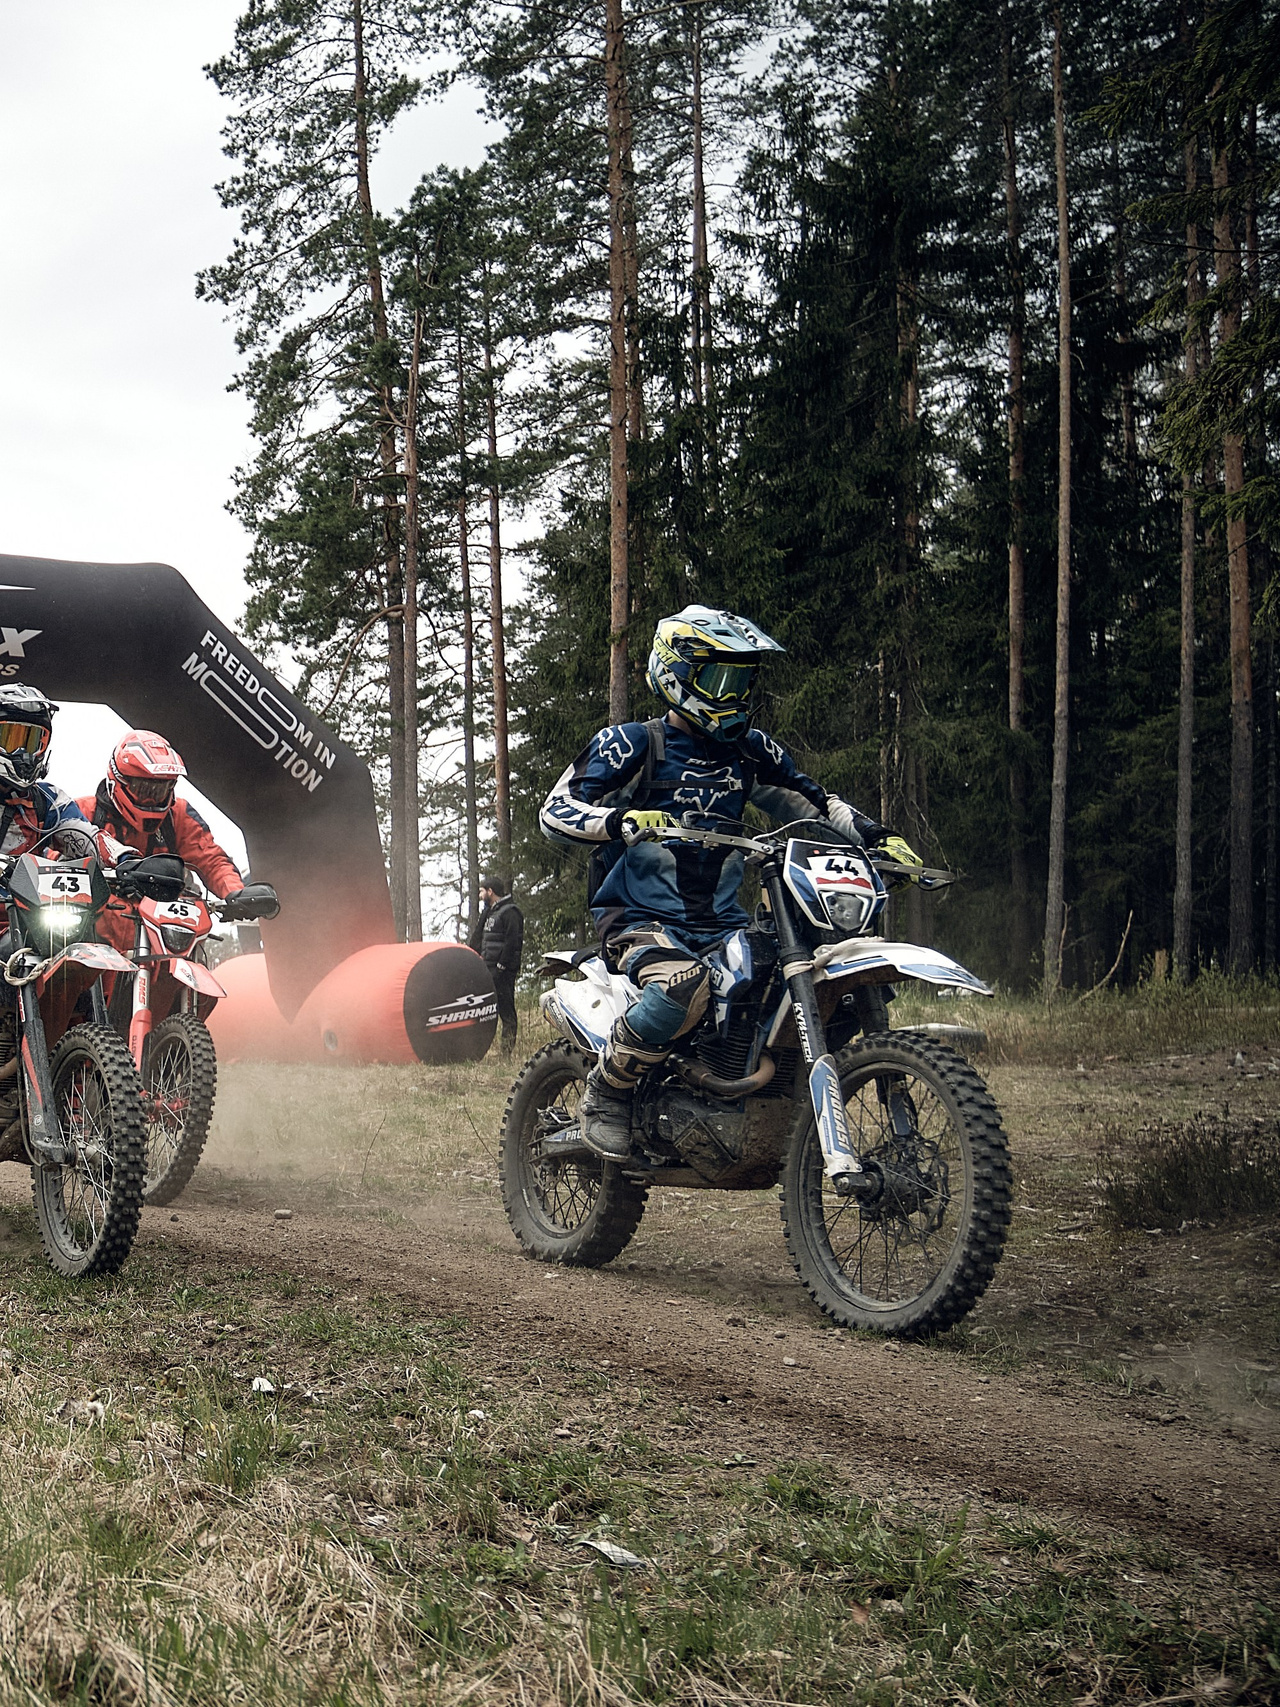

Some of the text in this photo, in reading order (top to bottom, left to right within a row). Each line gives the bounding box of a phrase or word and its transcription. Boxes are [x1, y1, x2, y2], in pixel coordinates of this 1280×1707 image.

[200, 630, 336, 770] FREEDOM IN
[181, 651, 323, 793] MOTION
[825, 858, 859, 876] 44
[51, 876, 80, 893] 43
[167, 903, 189, 917] 45
[669, 964, 703, 987] thor
[425, 1003, 497, 1027] SHARMAX
[826, 1074, 851, 1151] PROGASI
